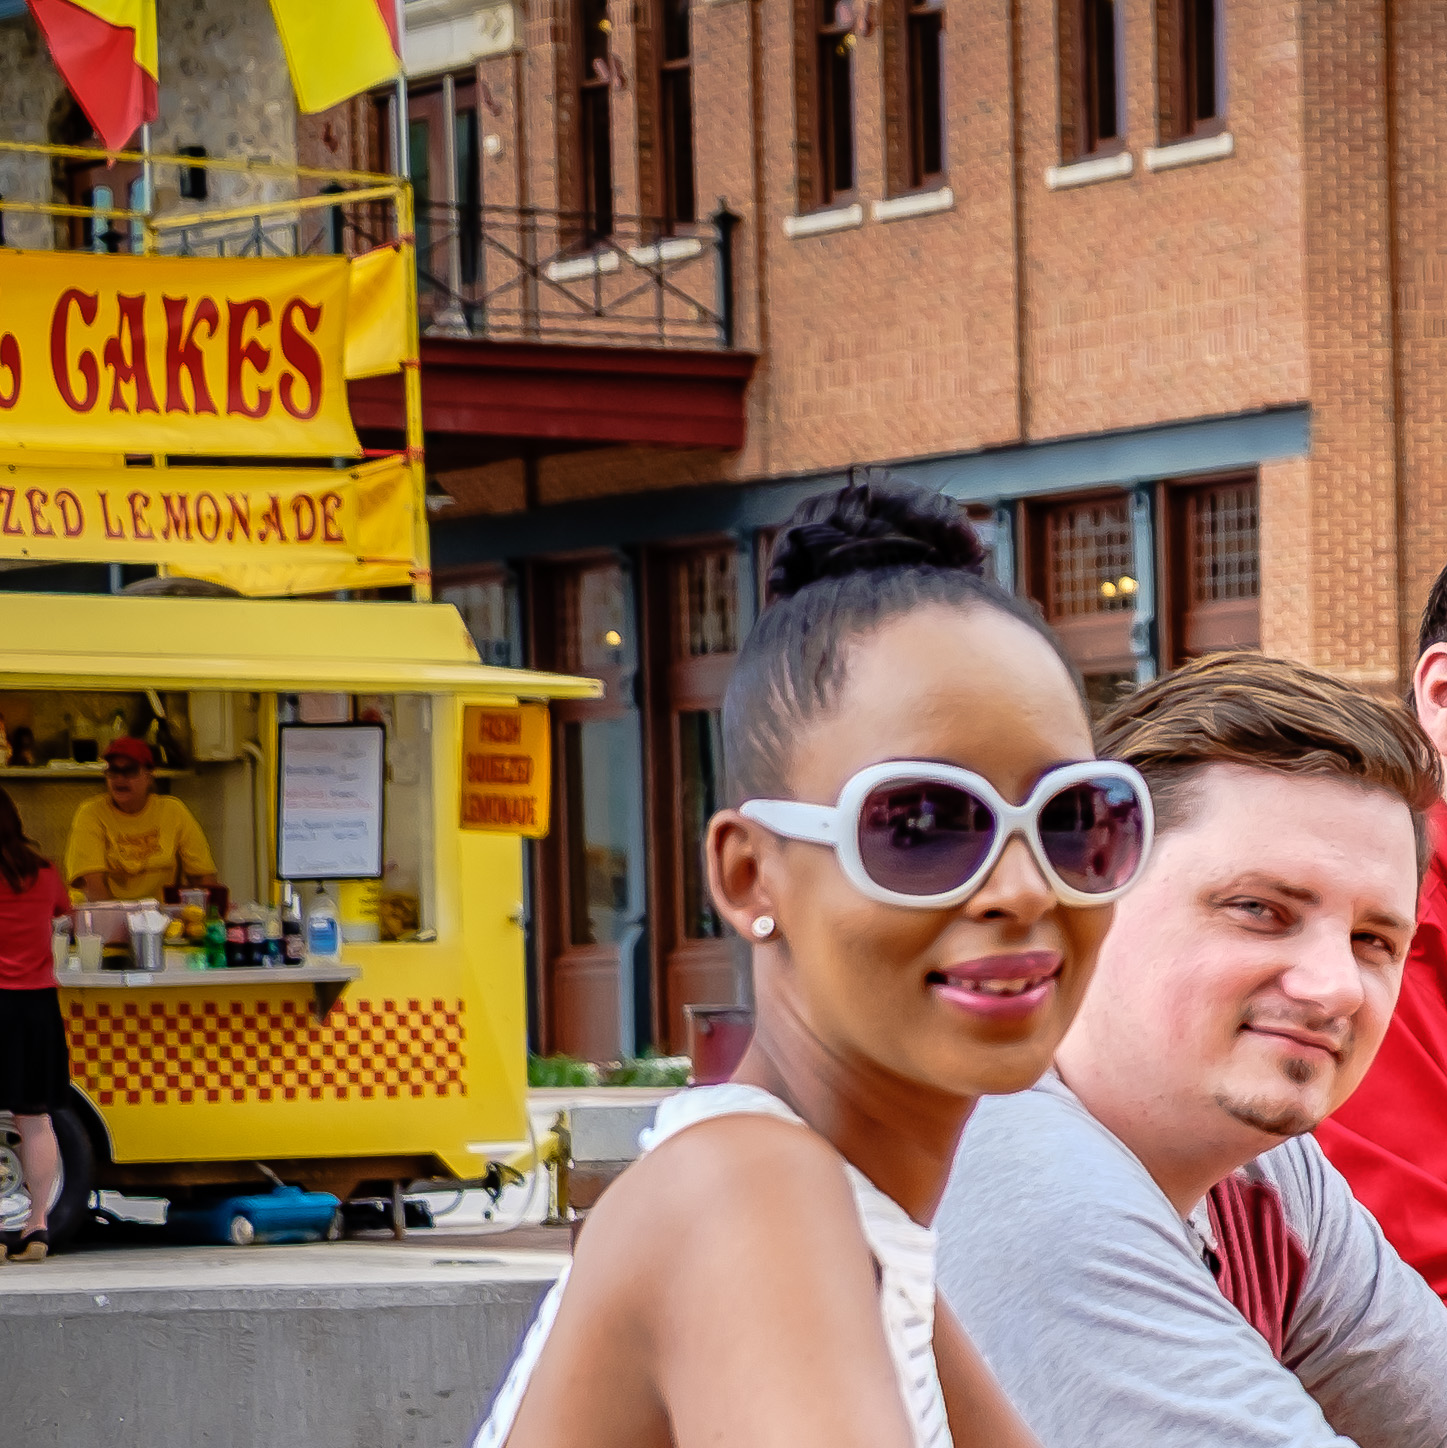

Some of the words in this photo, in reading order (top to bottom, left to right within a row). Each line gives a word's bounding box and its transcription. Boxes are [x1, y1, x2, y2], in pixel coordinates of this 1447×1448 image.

[49, 286, 324, 421] CAKES
[0, 487, 85, 538] ZED
[98, 490, 345, 543] LEMONADE
